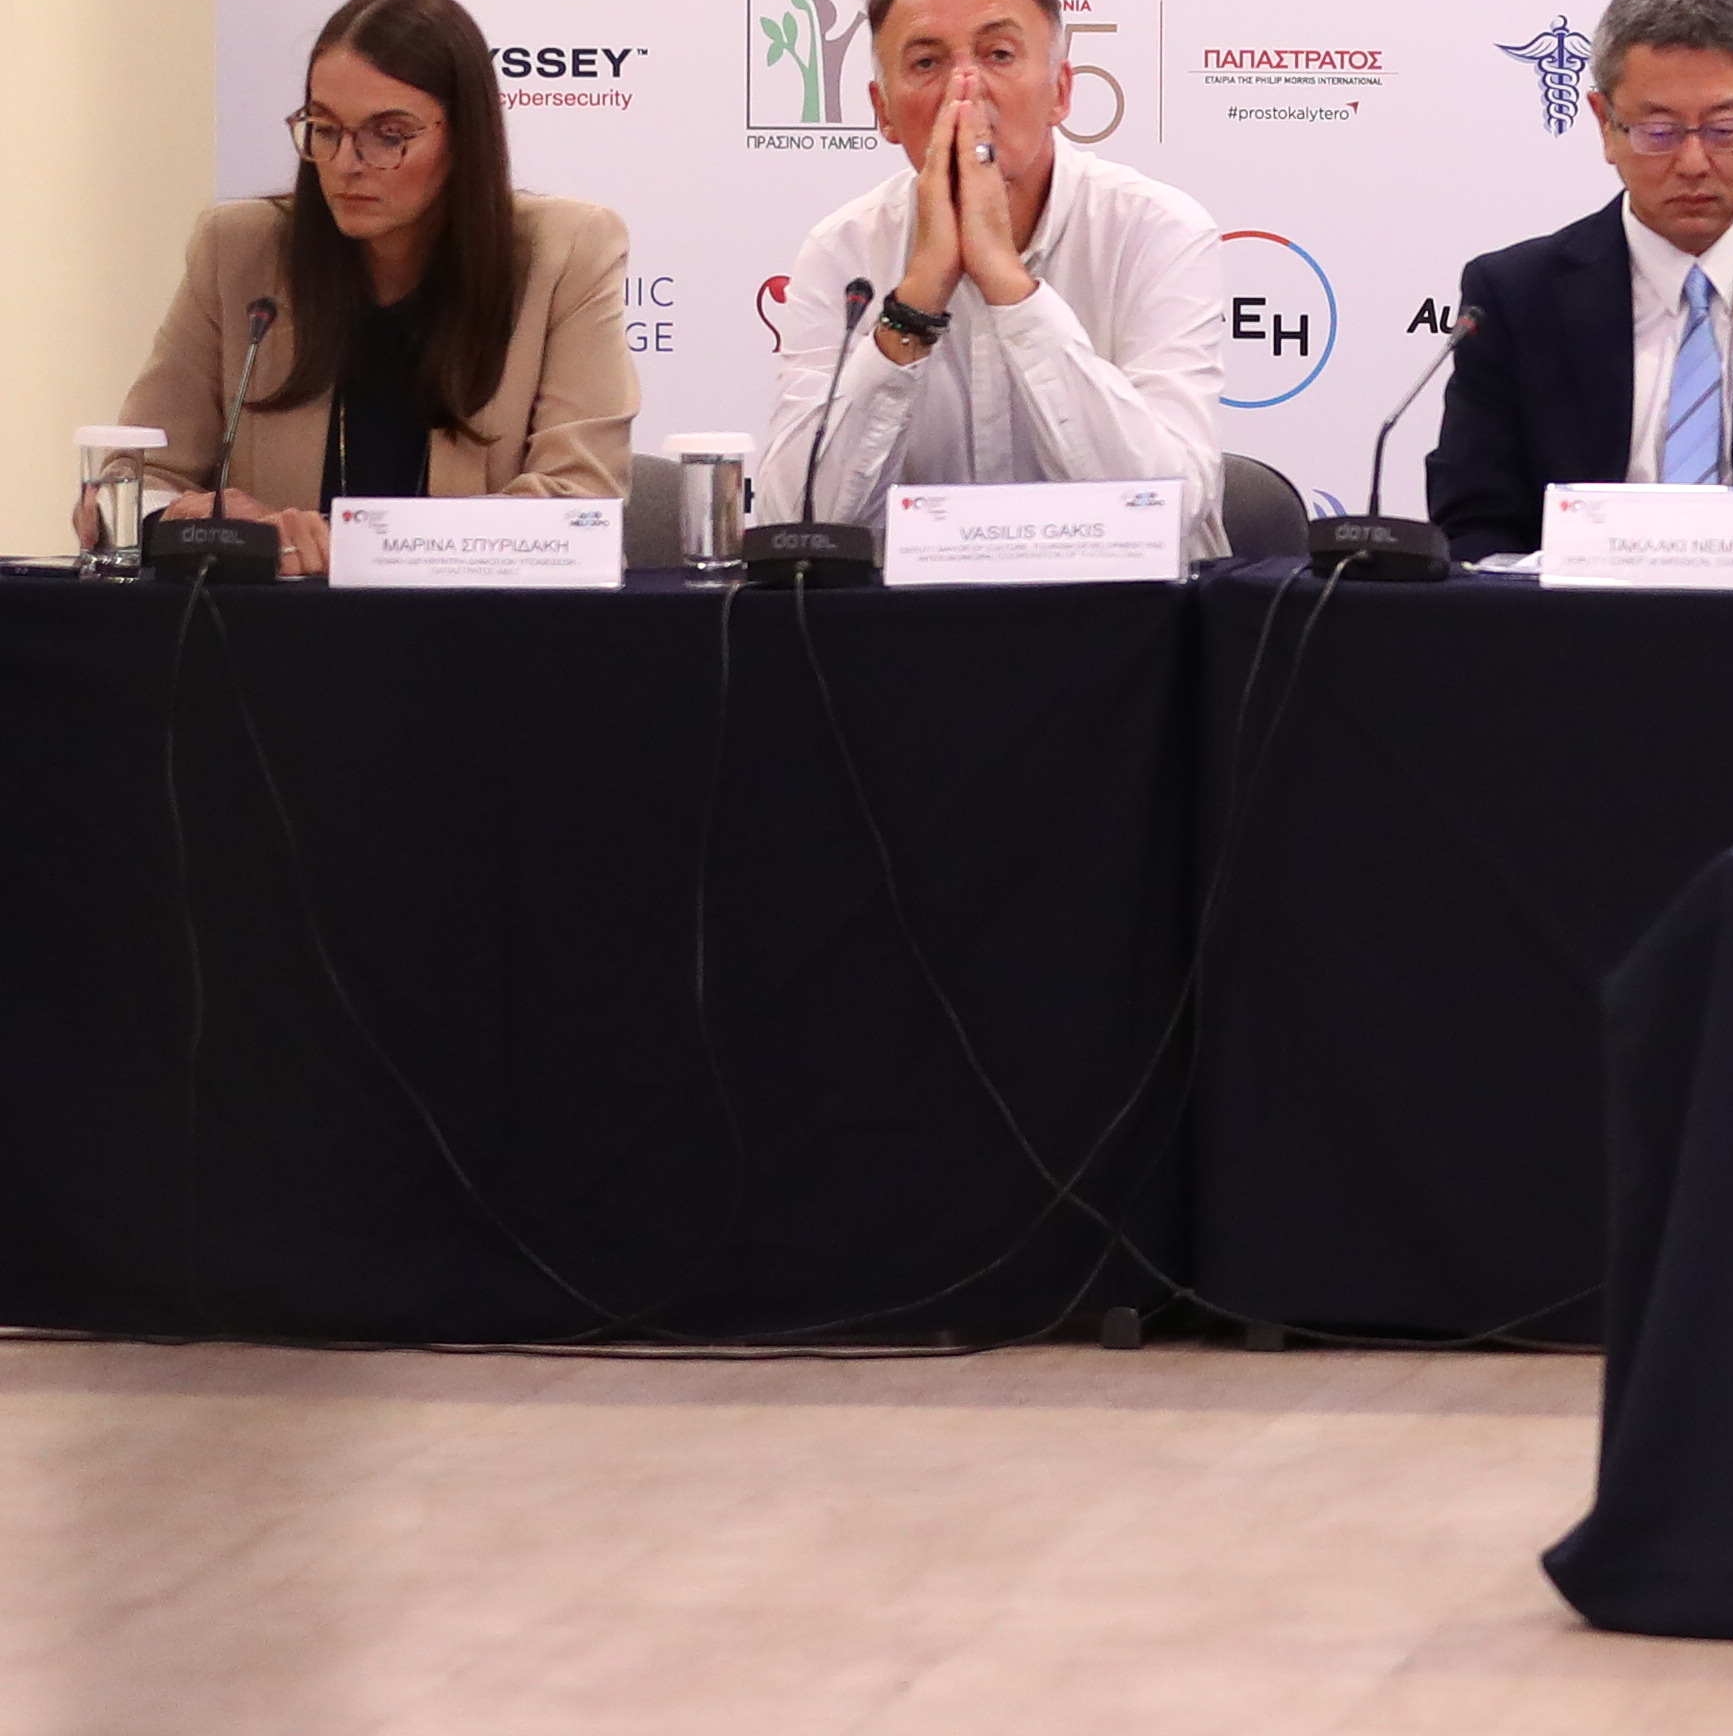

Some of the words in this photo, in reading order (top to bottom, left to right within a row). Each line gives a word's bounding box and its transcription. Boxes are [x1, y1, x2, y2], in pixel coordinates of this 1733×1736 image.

[1204, 49, 1383, 70] ΠΑΠΑΣΤΡΑΤΟΣ
[1226, 103, 1351, 124] #prostokalytero
[746, 135, 815, 150] ΠΡΑΣΙΝΟ
[820, 135, 878, 150] ΤΑΜΕΙΟ
[960, 525, 1036, 540] VASILIS
[1042, 523, 1105, 538] GAKIS
